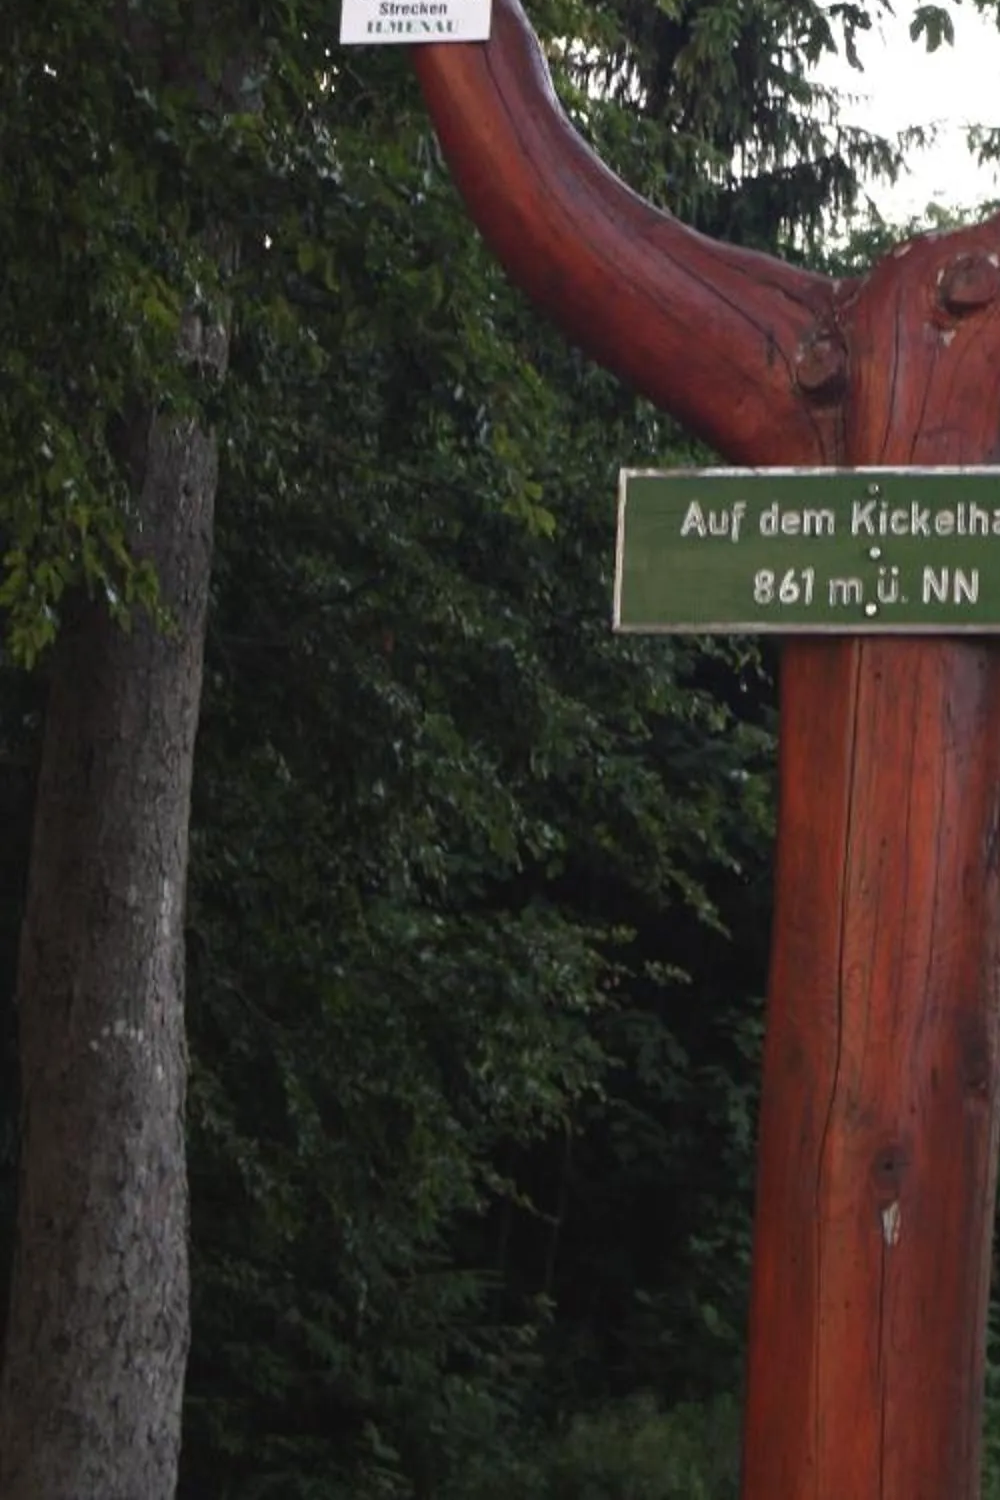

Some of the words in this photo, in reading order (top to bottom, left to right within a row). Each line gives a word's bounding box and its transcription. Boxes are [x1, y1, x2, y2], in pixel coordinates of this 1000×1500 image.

[378, 2, 448, 16] Strecken
[680, 500, 747, 544] Auf
[759, 501, 835, 537] dem
[752, 566, 816, 606] 861
[828, 575, 864, 606] m
[921, 568, 981, 605] NN
